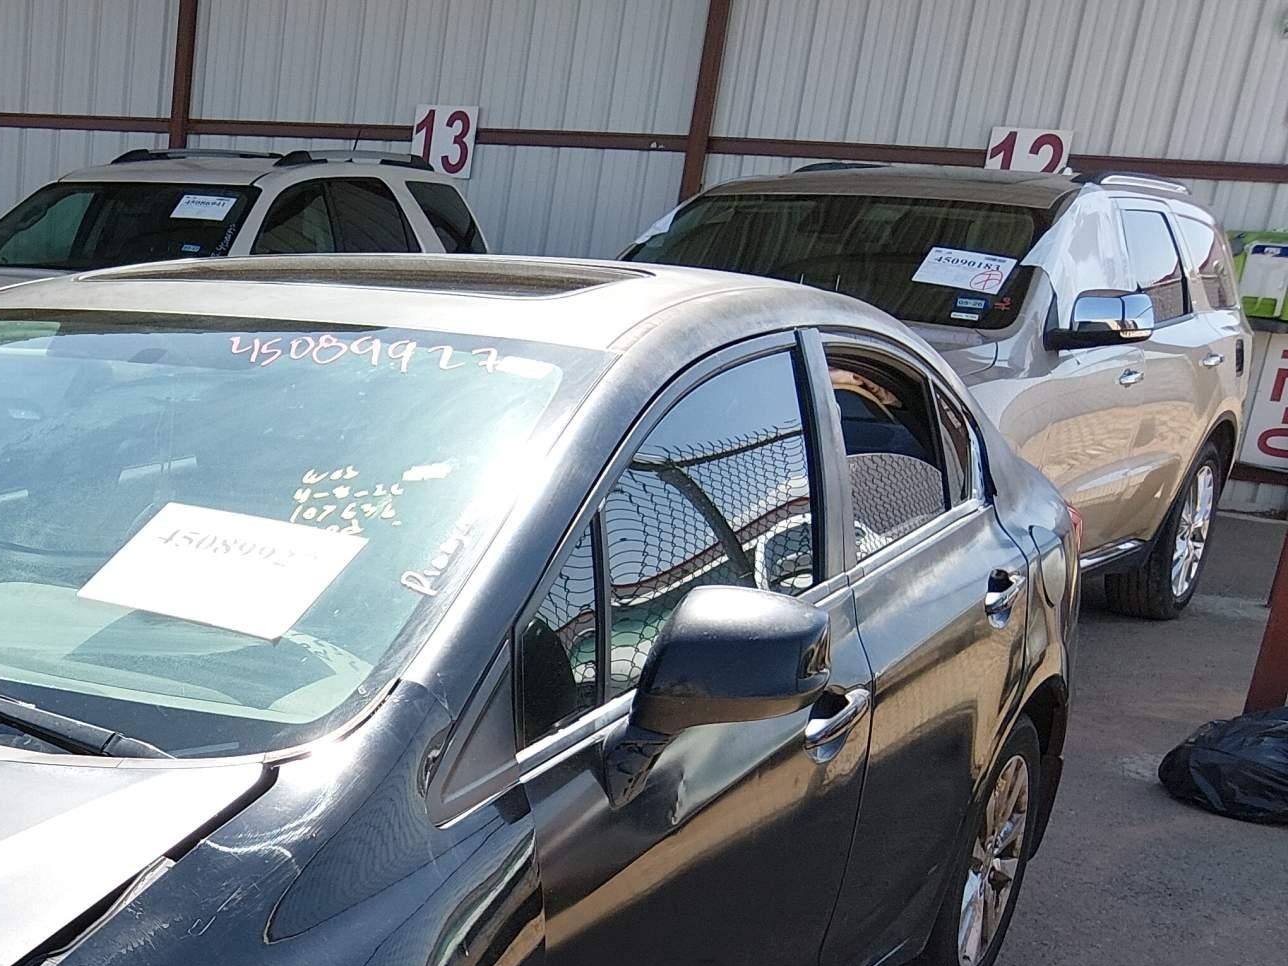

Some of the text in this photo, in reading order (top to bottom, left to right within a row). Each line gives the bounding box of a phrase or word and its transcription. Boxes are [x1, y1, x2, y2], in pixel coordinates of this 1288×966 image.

[415, 109, 471, 174] 13
[988, 130, 1064, 174] 12
[934, 256, 1001, 271] 45090183
[229, 334, 500, 374] 45089927
